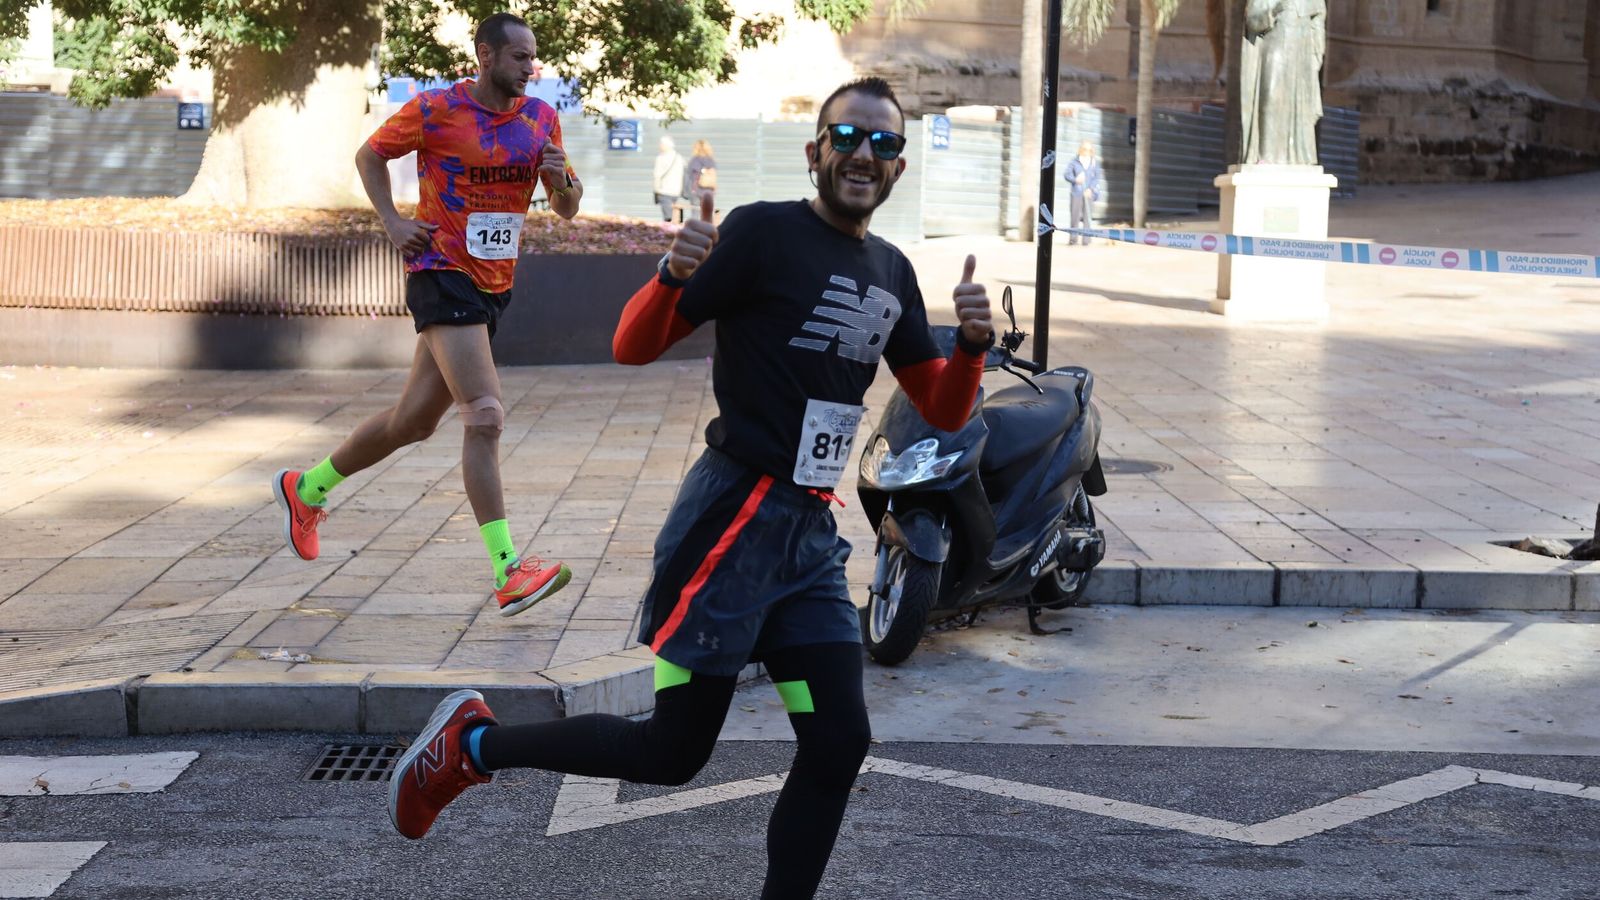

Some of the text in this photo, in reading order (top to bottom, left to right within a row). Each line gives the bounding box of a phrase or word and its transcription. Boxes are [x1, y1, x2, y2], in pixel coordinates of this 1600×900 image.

[470, 166, 532, 184] ENTRENA
[469, 192, 513, 201] PERSONAL
[476, 229, 512, 245] 143
[1039, 529, 1062, 567] YAMAHA
